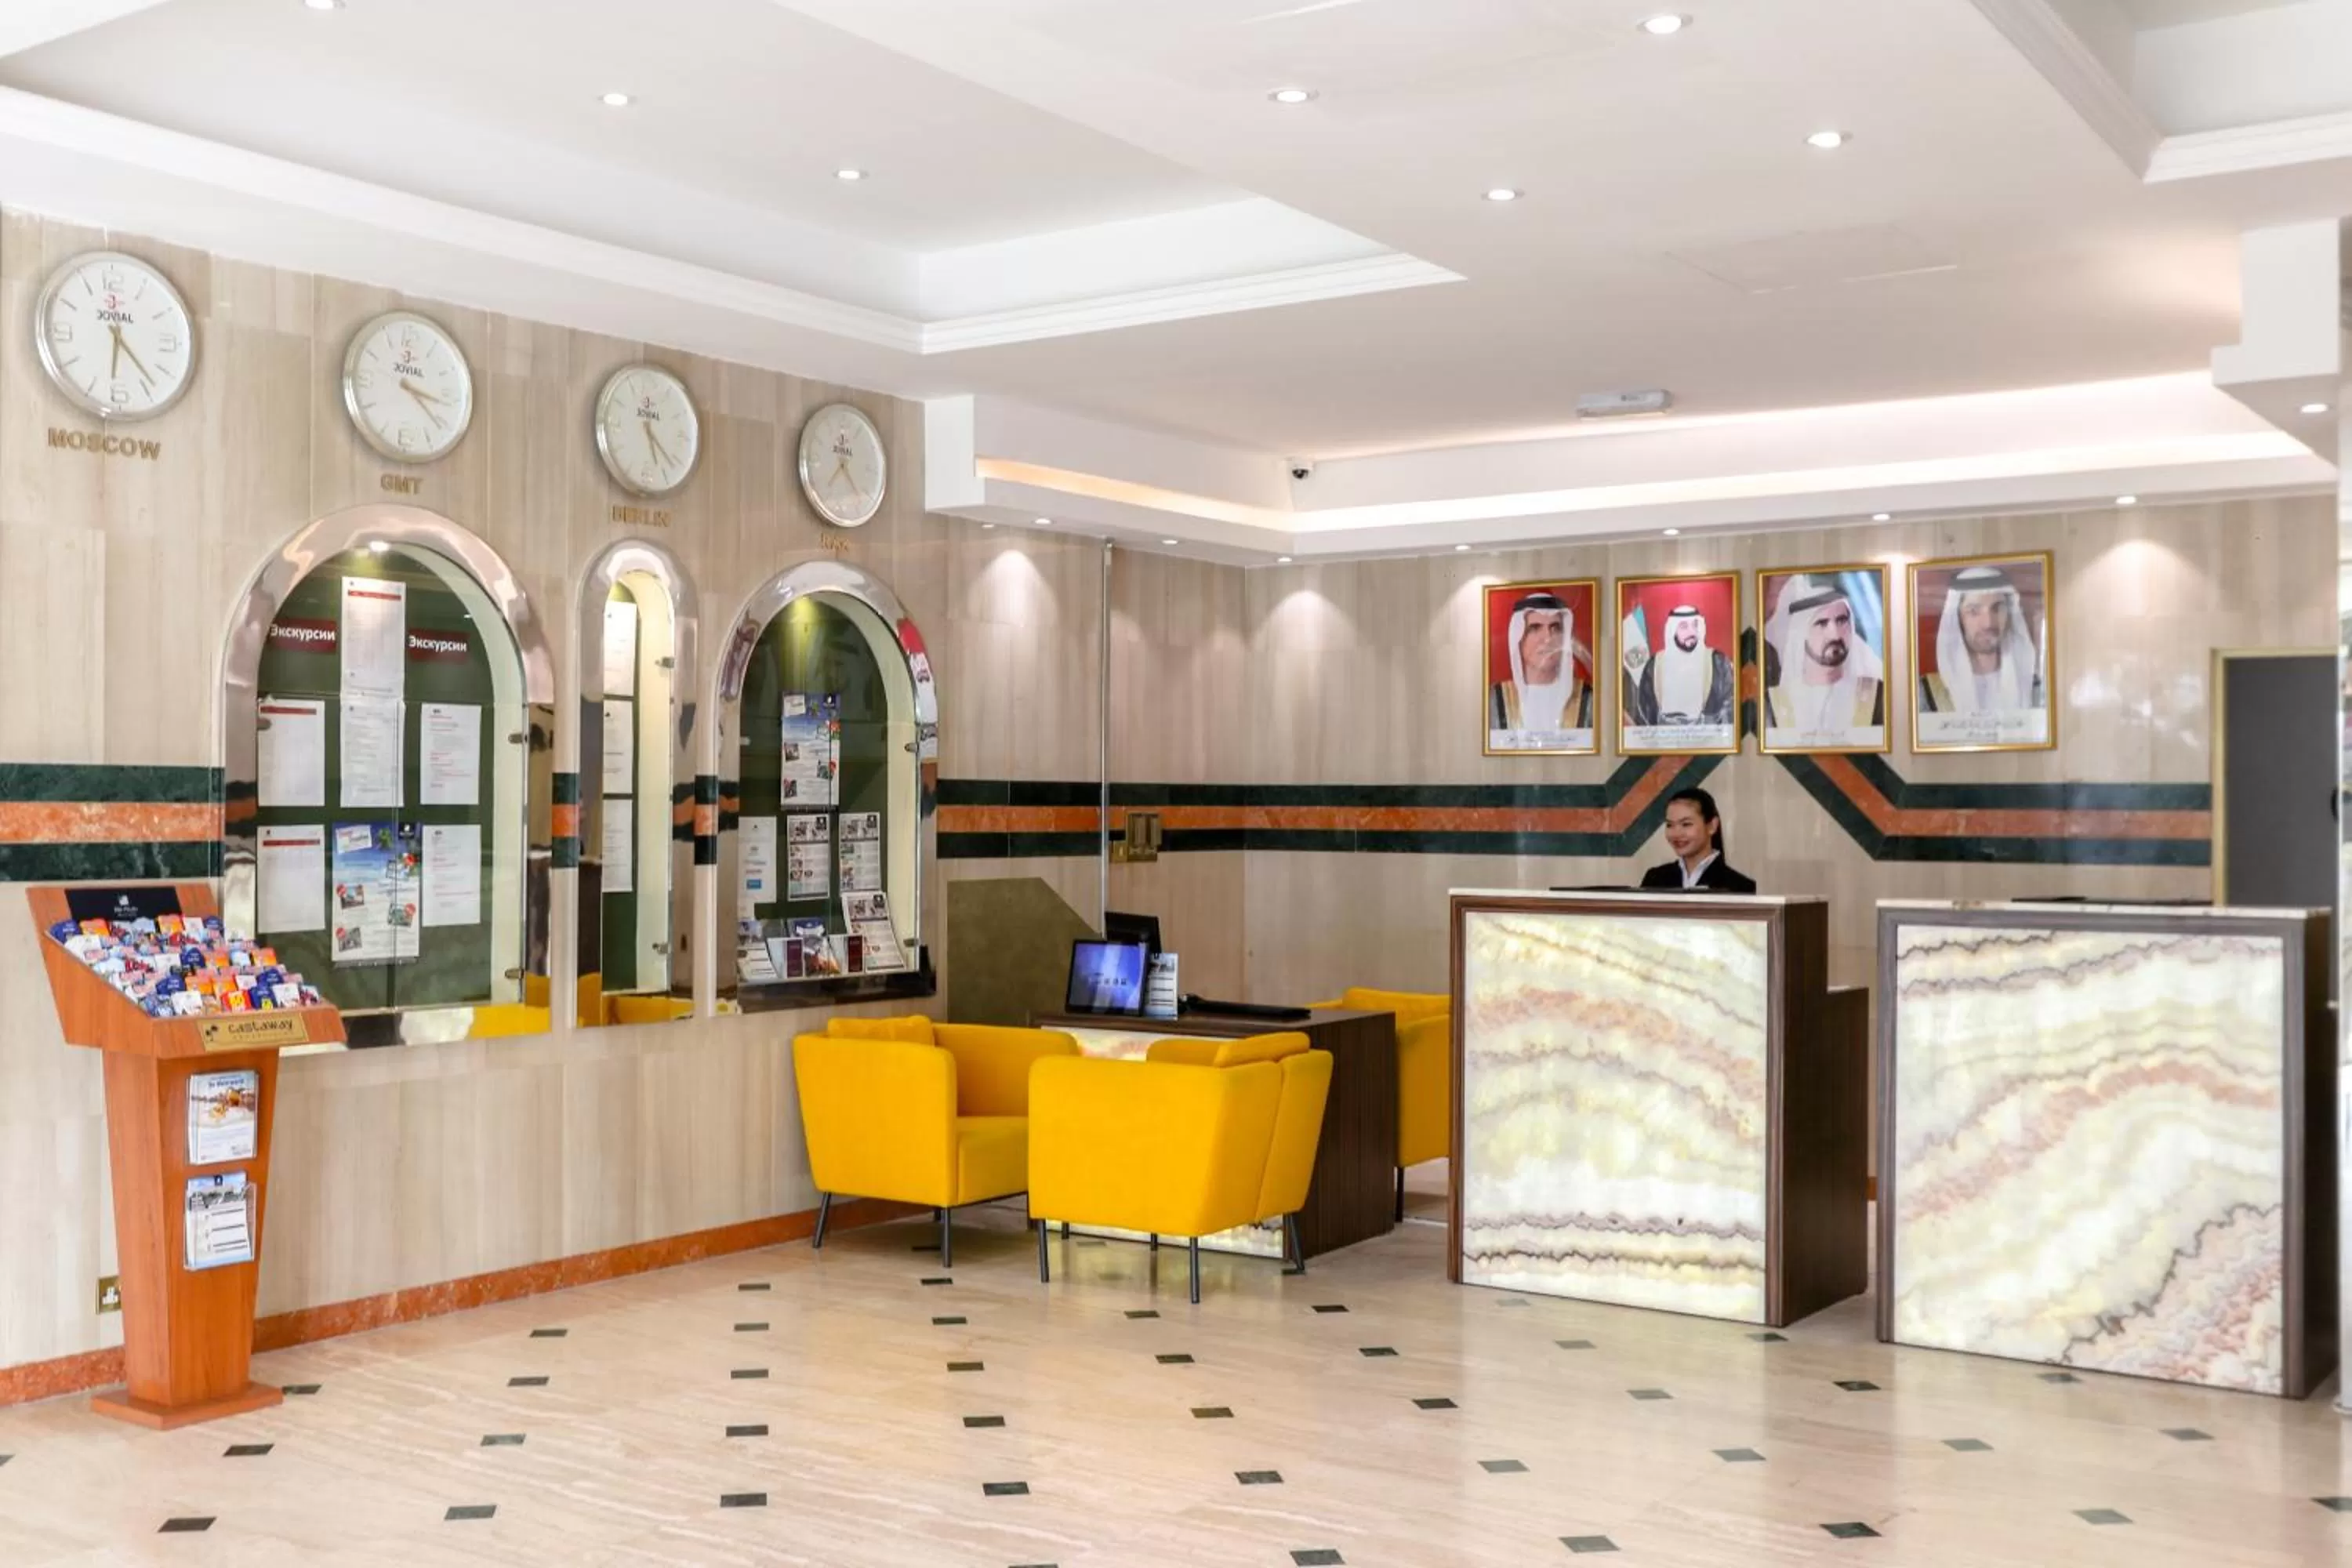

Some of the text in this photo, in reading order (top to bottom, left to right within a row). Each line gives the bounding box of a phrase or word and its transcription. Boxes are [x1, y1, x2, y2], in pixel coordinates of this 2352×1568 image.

[96, 310, 134, 323] JOVIAL
[394, 362, 424, 378] JOVIAL
[47, 426, 162, 461] MOSCOW
[380, 474, 423, 495] GMT
[611, 504, 672, 528] BERLIN
[270, 624, 336, 642] Экскурсии
[408, 635, 467, 653] Экскурсии
